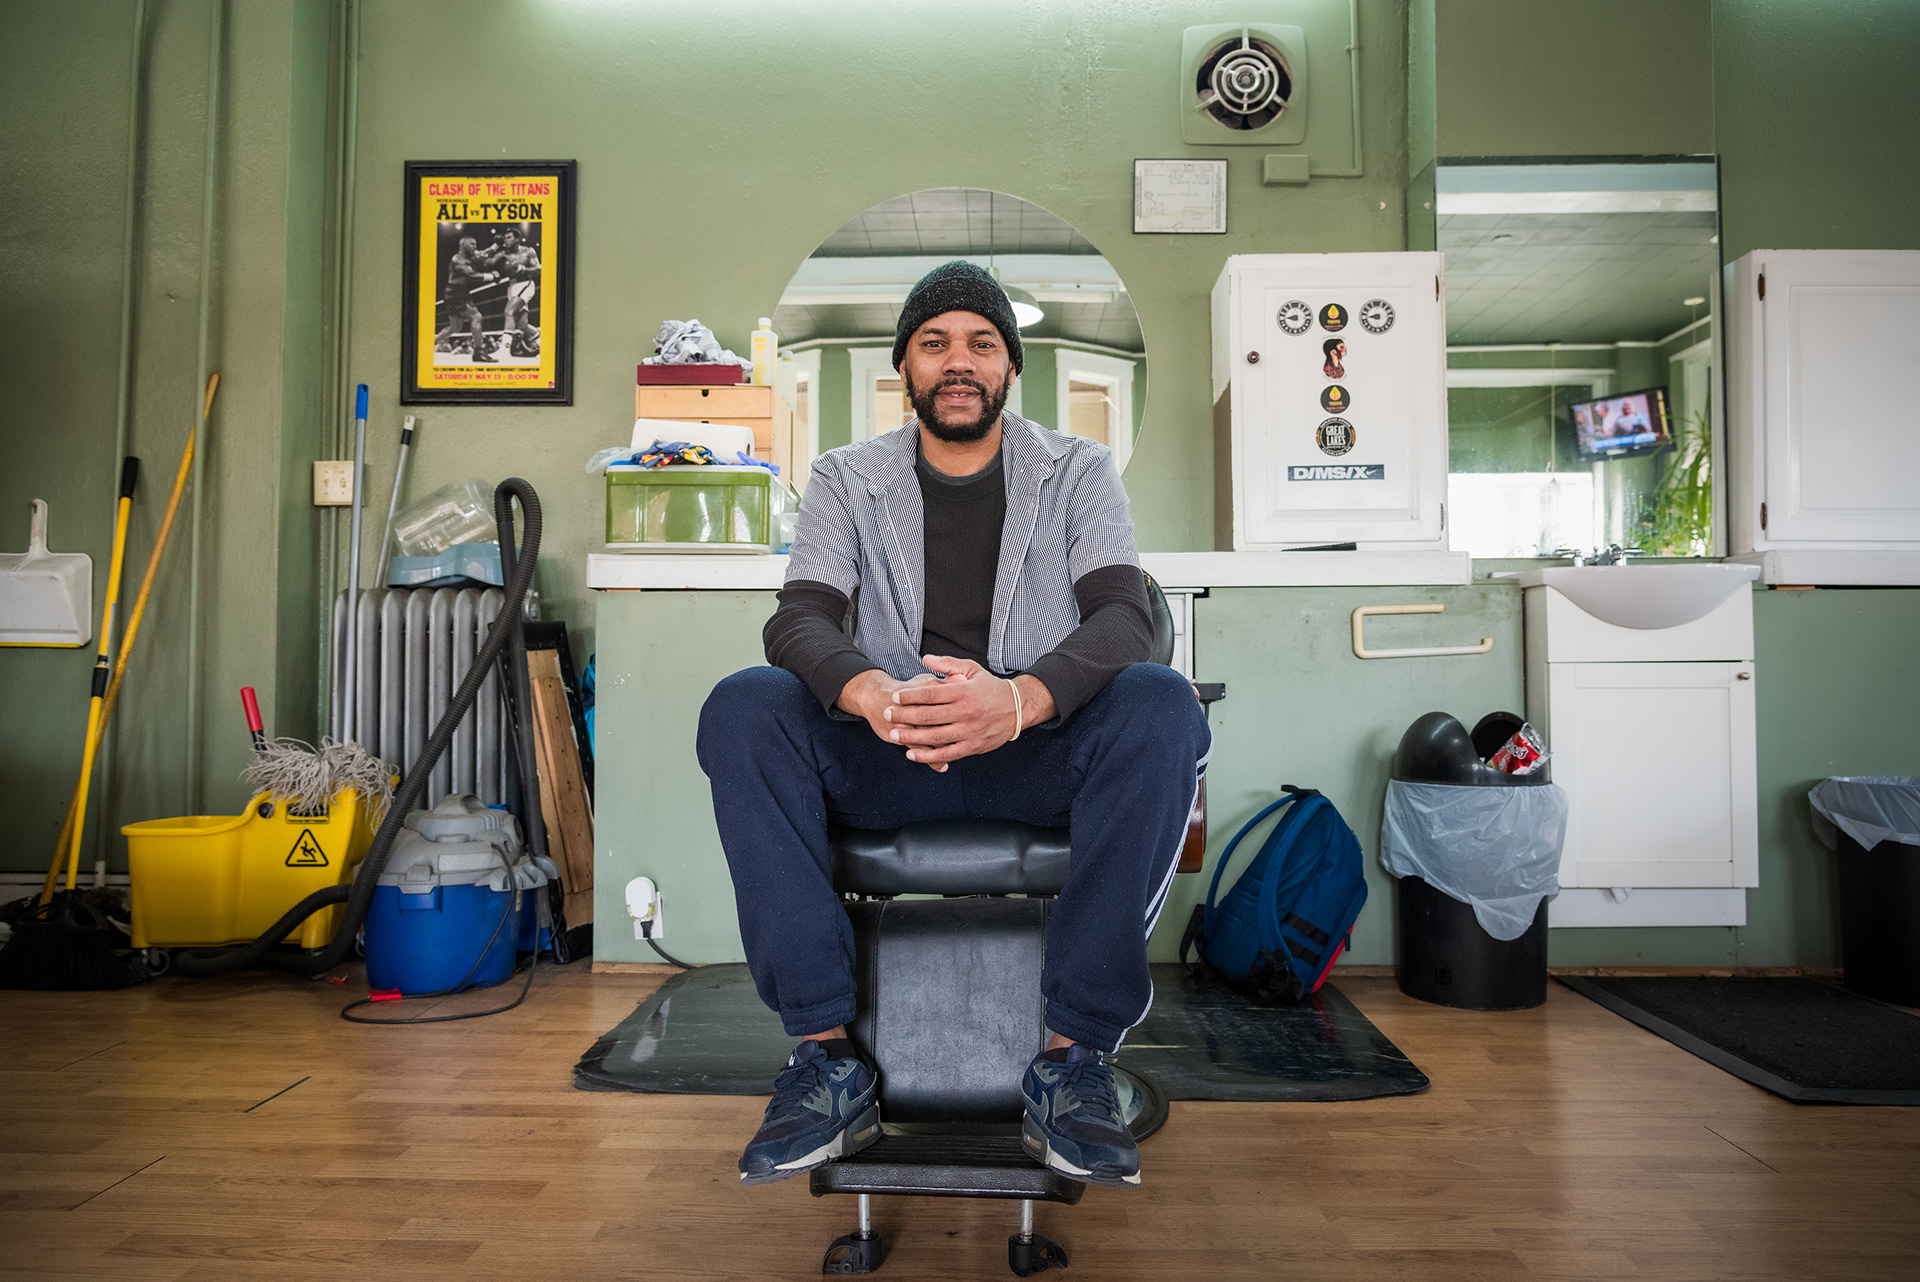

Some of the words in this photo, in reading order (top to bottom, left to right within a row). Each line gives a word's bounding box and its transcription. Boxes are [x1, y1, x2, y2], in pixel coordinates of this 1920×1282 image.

[429, 183, 464, 196] CLASH
[468, 183, 481, 196] OF
[486, 183, 506, 196] THE
[510, 183, 550, 196] TITANS
[436, 204, 468, 220] ALI
[480, 203, 542, 220] TYSON
[1325, 425, 1345, 436] GREAT
[1326, 435, 1347, 446] LAKES
